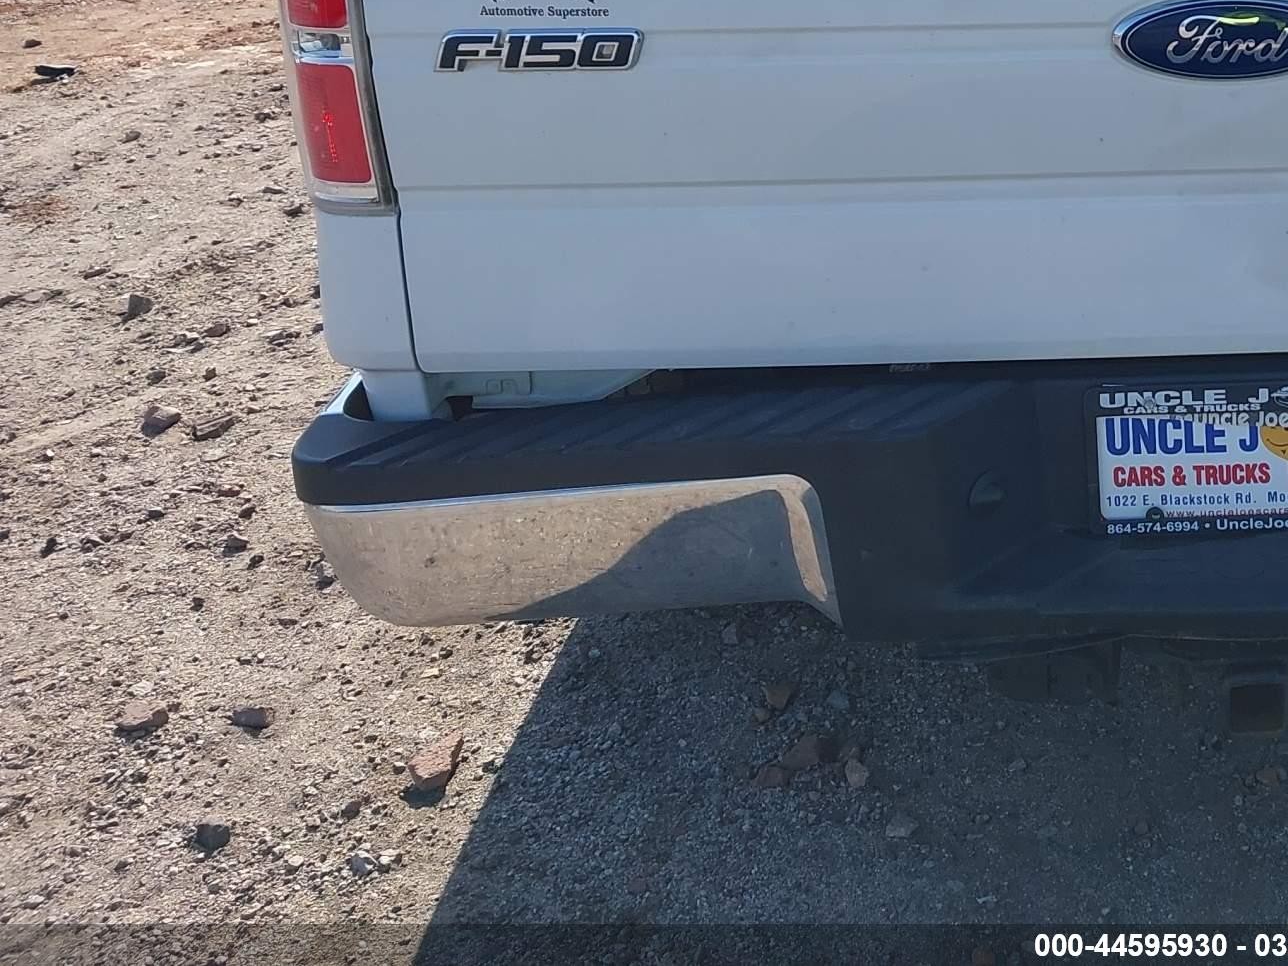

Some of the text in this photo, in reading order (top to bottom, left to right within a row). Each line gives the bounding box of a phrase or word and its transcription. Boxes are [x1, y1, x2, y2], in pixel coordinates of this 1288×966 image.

[479, 5, 610, 20] Automotive Superstore
[434, 28, 645, 73] F-150
[1100, 389, 1227, 408] UNCLE
[1123, 402, 1261, 415] CARS & TRUCKS
[1105, 417, 1228, 456] UNCLE
[1113, 462, 1271, 488] CARS & TRUCKS
[1106, 495, 1138, 507] 1022
[1142, 495, 1156, 506] E.
[1160, 492, 1231, 506] Blackstock
[1235, 492, 1257, 504] Rd.
[1107, 521, 1200, 535] 864-574-6994
